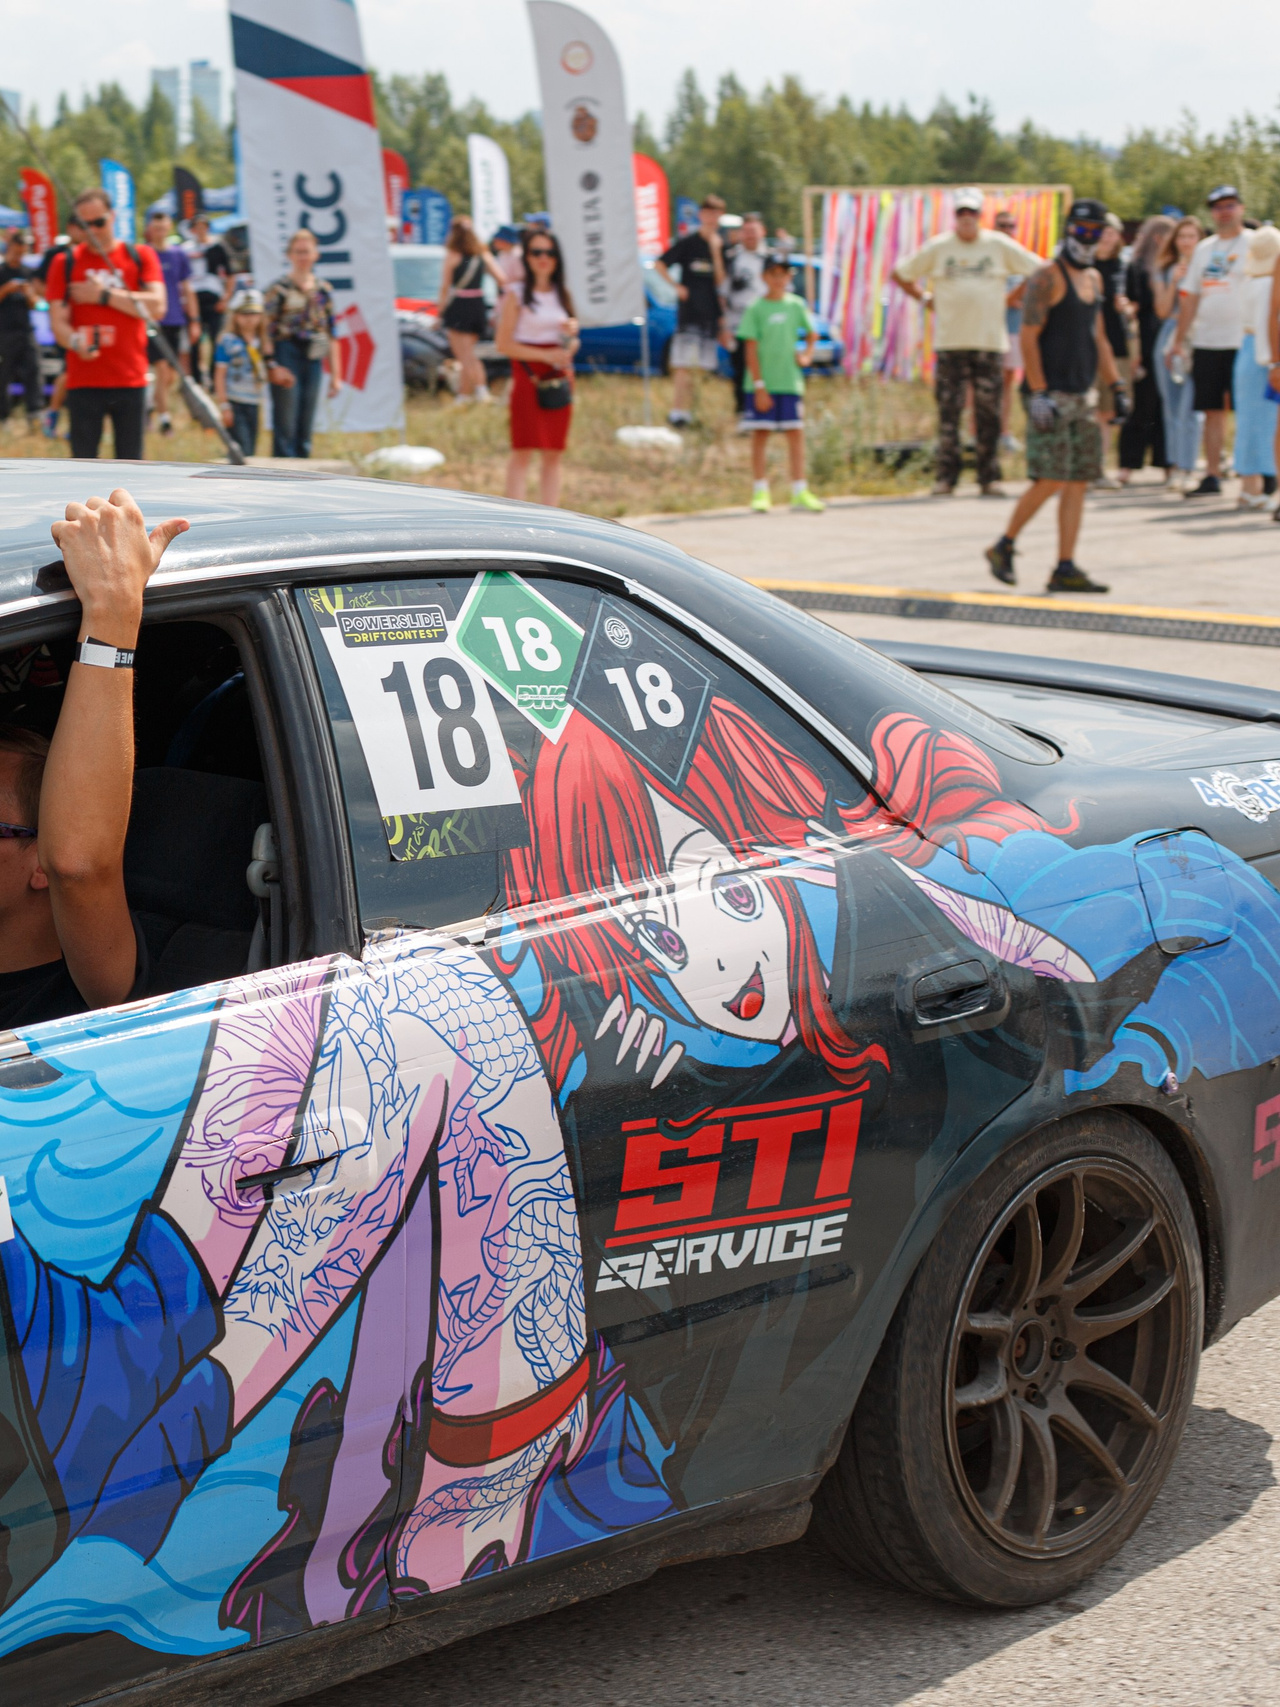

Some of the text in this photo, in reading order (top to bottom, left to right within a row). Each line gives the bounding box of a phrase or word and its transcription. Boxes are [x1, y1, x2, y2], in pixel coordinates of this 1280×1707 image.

[341, 612, 444, 632] POWERSLIDE
[481, 616, 562, 672] 18
[381, 656, 491, 790] 18
[604, 662, 685, 731] 18
[614, 1098, 863, 1232] STI
[595, 1213, 849, 1292] SERVICE
